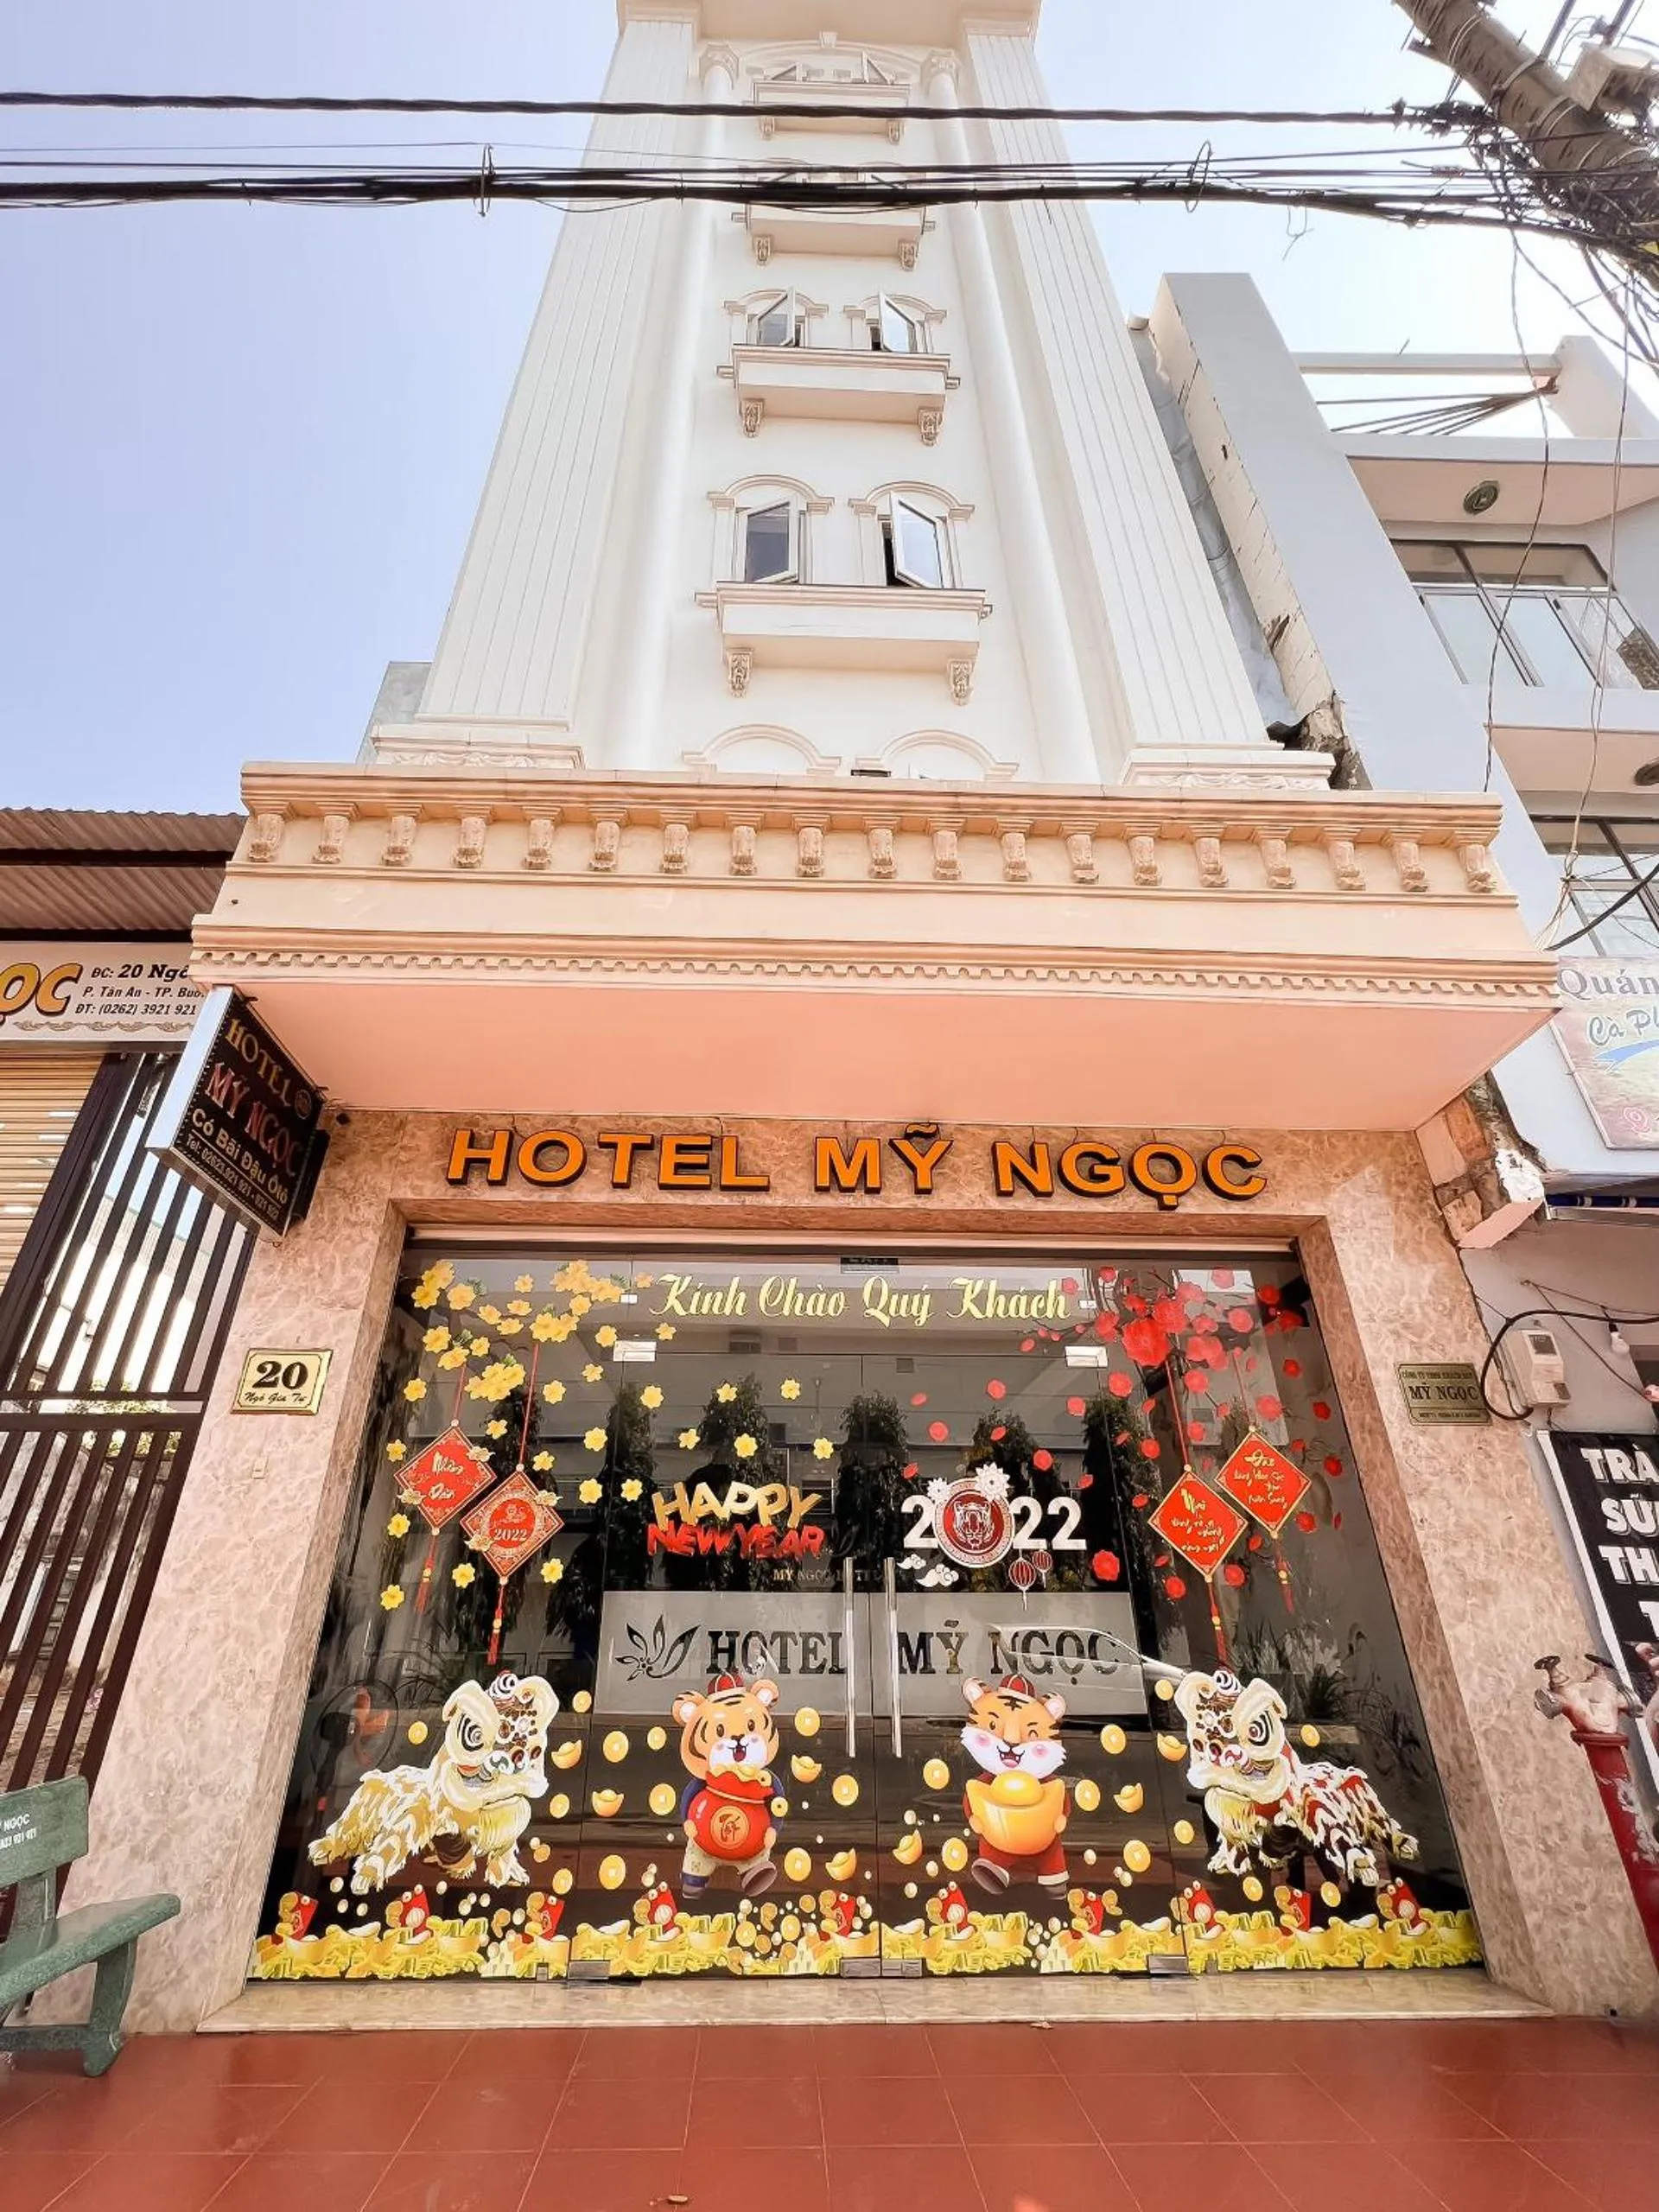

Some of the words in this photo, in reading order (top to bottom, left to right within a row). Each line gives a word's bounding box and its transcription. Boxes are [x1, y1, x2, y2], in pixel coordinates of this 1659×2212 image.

[118, 963, 144, 979] 20
[1556, 968, 1659, 1001] Quán
[82, 986, 94, 997] P.
[154, 986, 174, 997] TP.
[98, 1004, 137, 1016] (0262)
[141, 1004, 170, 1015] 3921
[174, 1005, 196, 1015] 921
[1589, 1015, 1624, 1046] Cà
[187, 1133, 201, 1155] Tel:
[192, 1109, 215, 1136] Có
[216, 1127, 241, 1160] Bãi
[241, 1151, 266, 1185] Đậu
[445, 1128, 771, 1192] HOTEL
[814, 1122, 954, 1194] MỸ
[991, 1140, 1268, 1211] NGỌC
[649, 1273, 748, 1317] Kính
[759, 1274, 849, 1318] Chào
[862, 1274, 934, 1328] Quý
[947, 1275, 1071, 1319] Khách
[251, 1360, 308, 1390] 20
[1408, 1382, 1431, 1400] MỸ
[1435, 1386, 1478, 1404] NGỌC
[1580, 1442, 1659, 1484] TRÀ
[652, 1481, 822, 1530] HAPPY
[493, 1528, 528, 1541] 2022
[648, 1521, 734, 1556] NEW
[734, 1522, 826, 1560] YEAR
[705, 1630, 847, 1675] HOTEL
[898, 1619, 969, 1675] MỸ
[990, 1629, 1121, 1685] NGỌC
